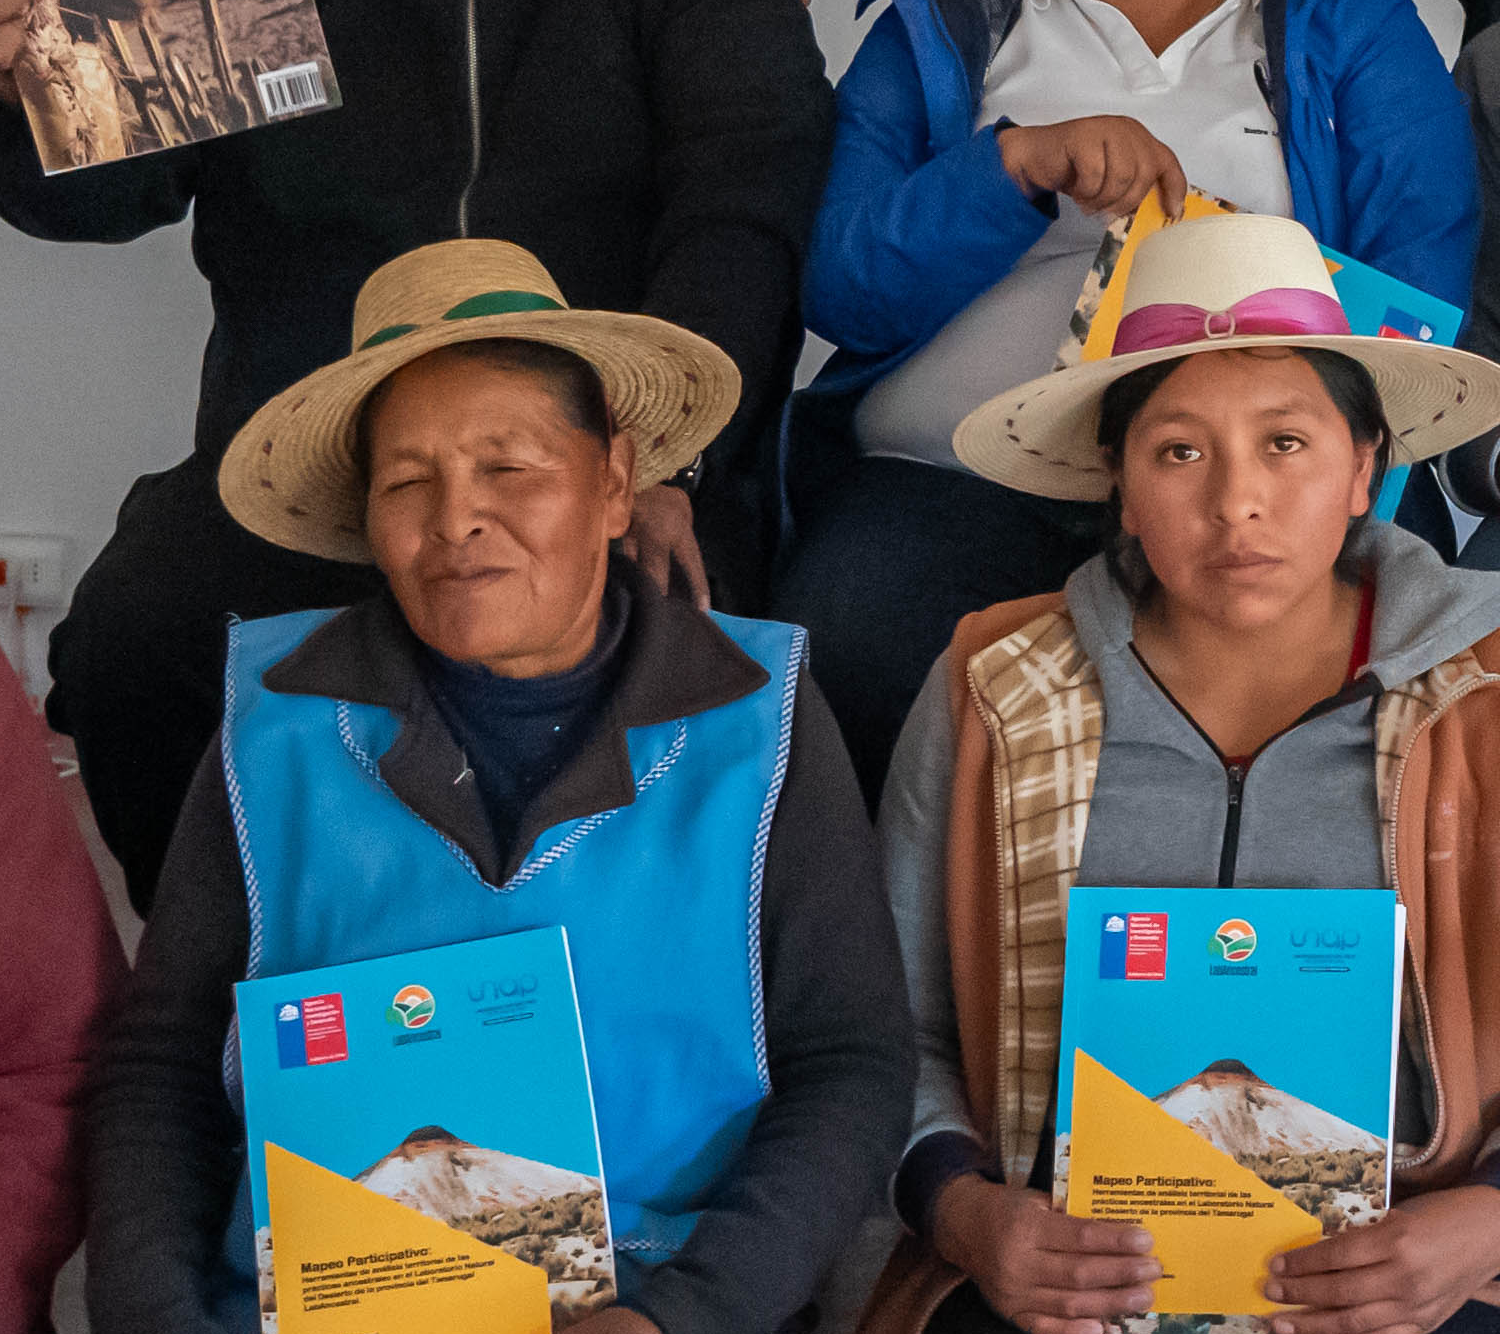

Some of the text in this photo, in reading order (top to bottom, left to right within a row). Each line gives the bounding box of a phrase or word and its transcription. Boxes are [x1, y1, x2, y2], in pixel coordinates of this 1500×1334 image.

[1092, 1175, 1216, 1188] Mapeo Participativo:
[300, 1248, 431, 1273] Mapeo Participativo:
